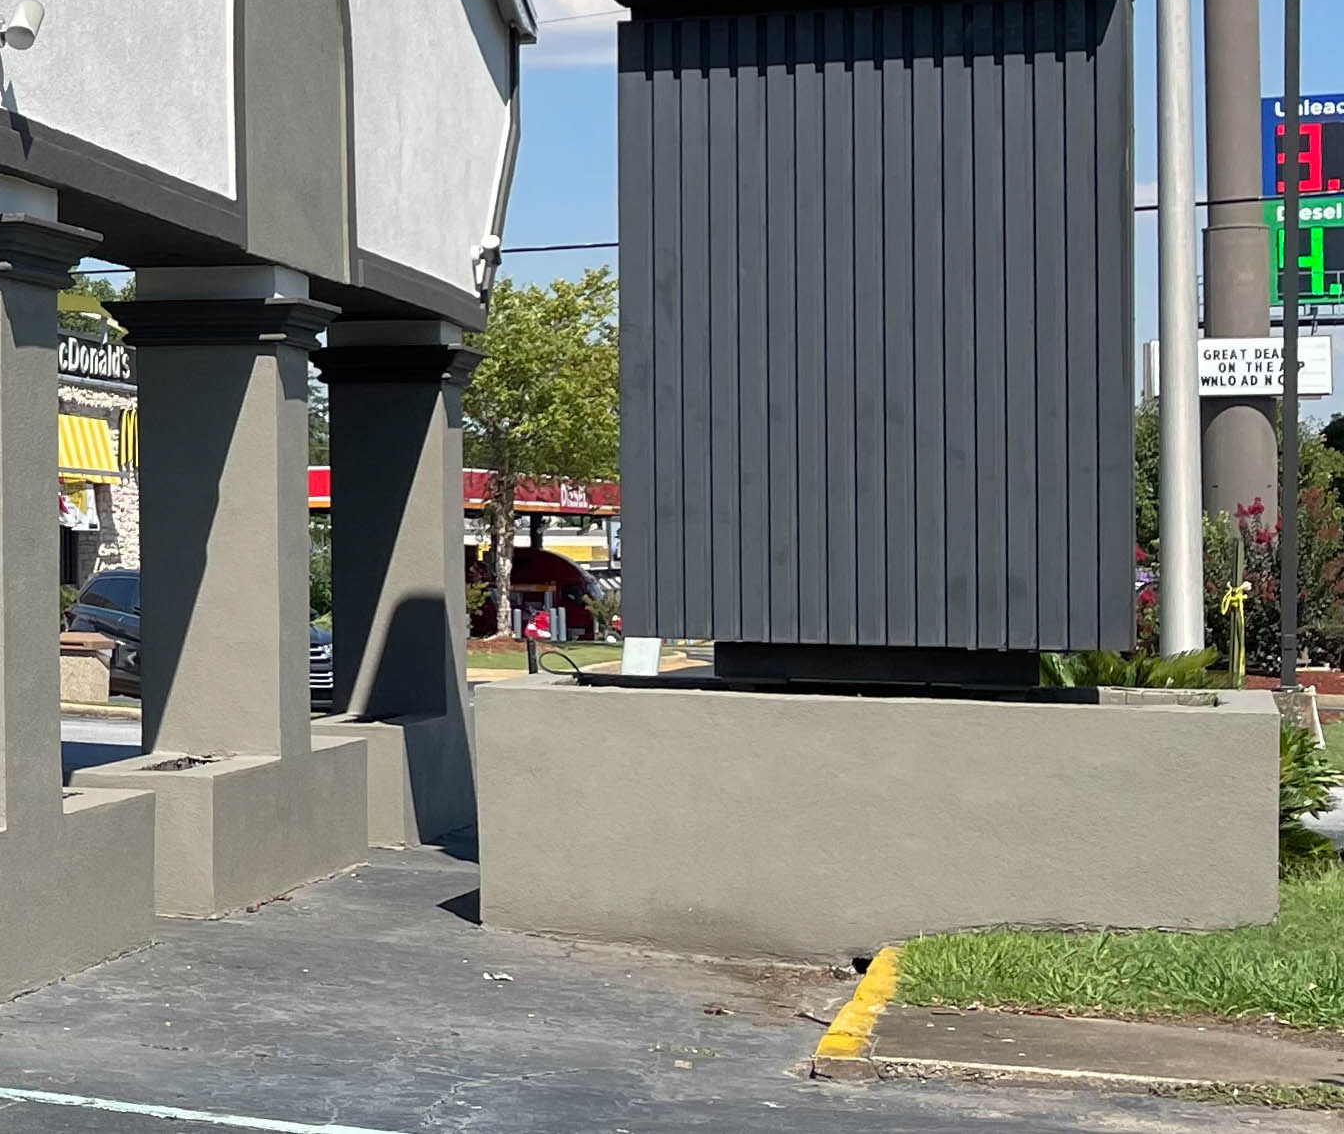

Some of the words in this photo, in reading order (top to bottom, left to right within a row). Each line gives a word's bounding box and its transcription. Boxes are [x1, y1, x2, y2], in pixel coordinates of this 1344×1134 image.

[1277, 202, 1342, 222] Desel
[58, 336, 131, 379] cDonald's
[1203, 348, 1247, 360] GREAT
[1255, 348, 1285, 359] DEAL
[1218, 362, 1236, 373] ON
[1246, 361, 1274, 372] THE
